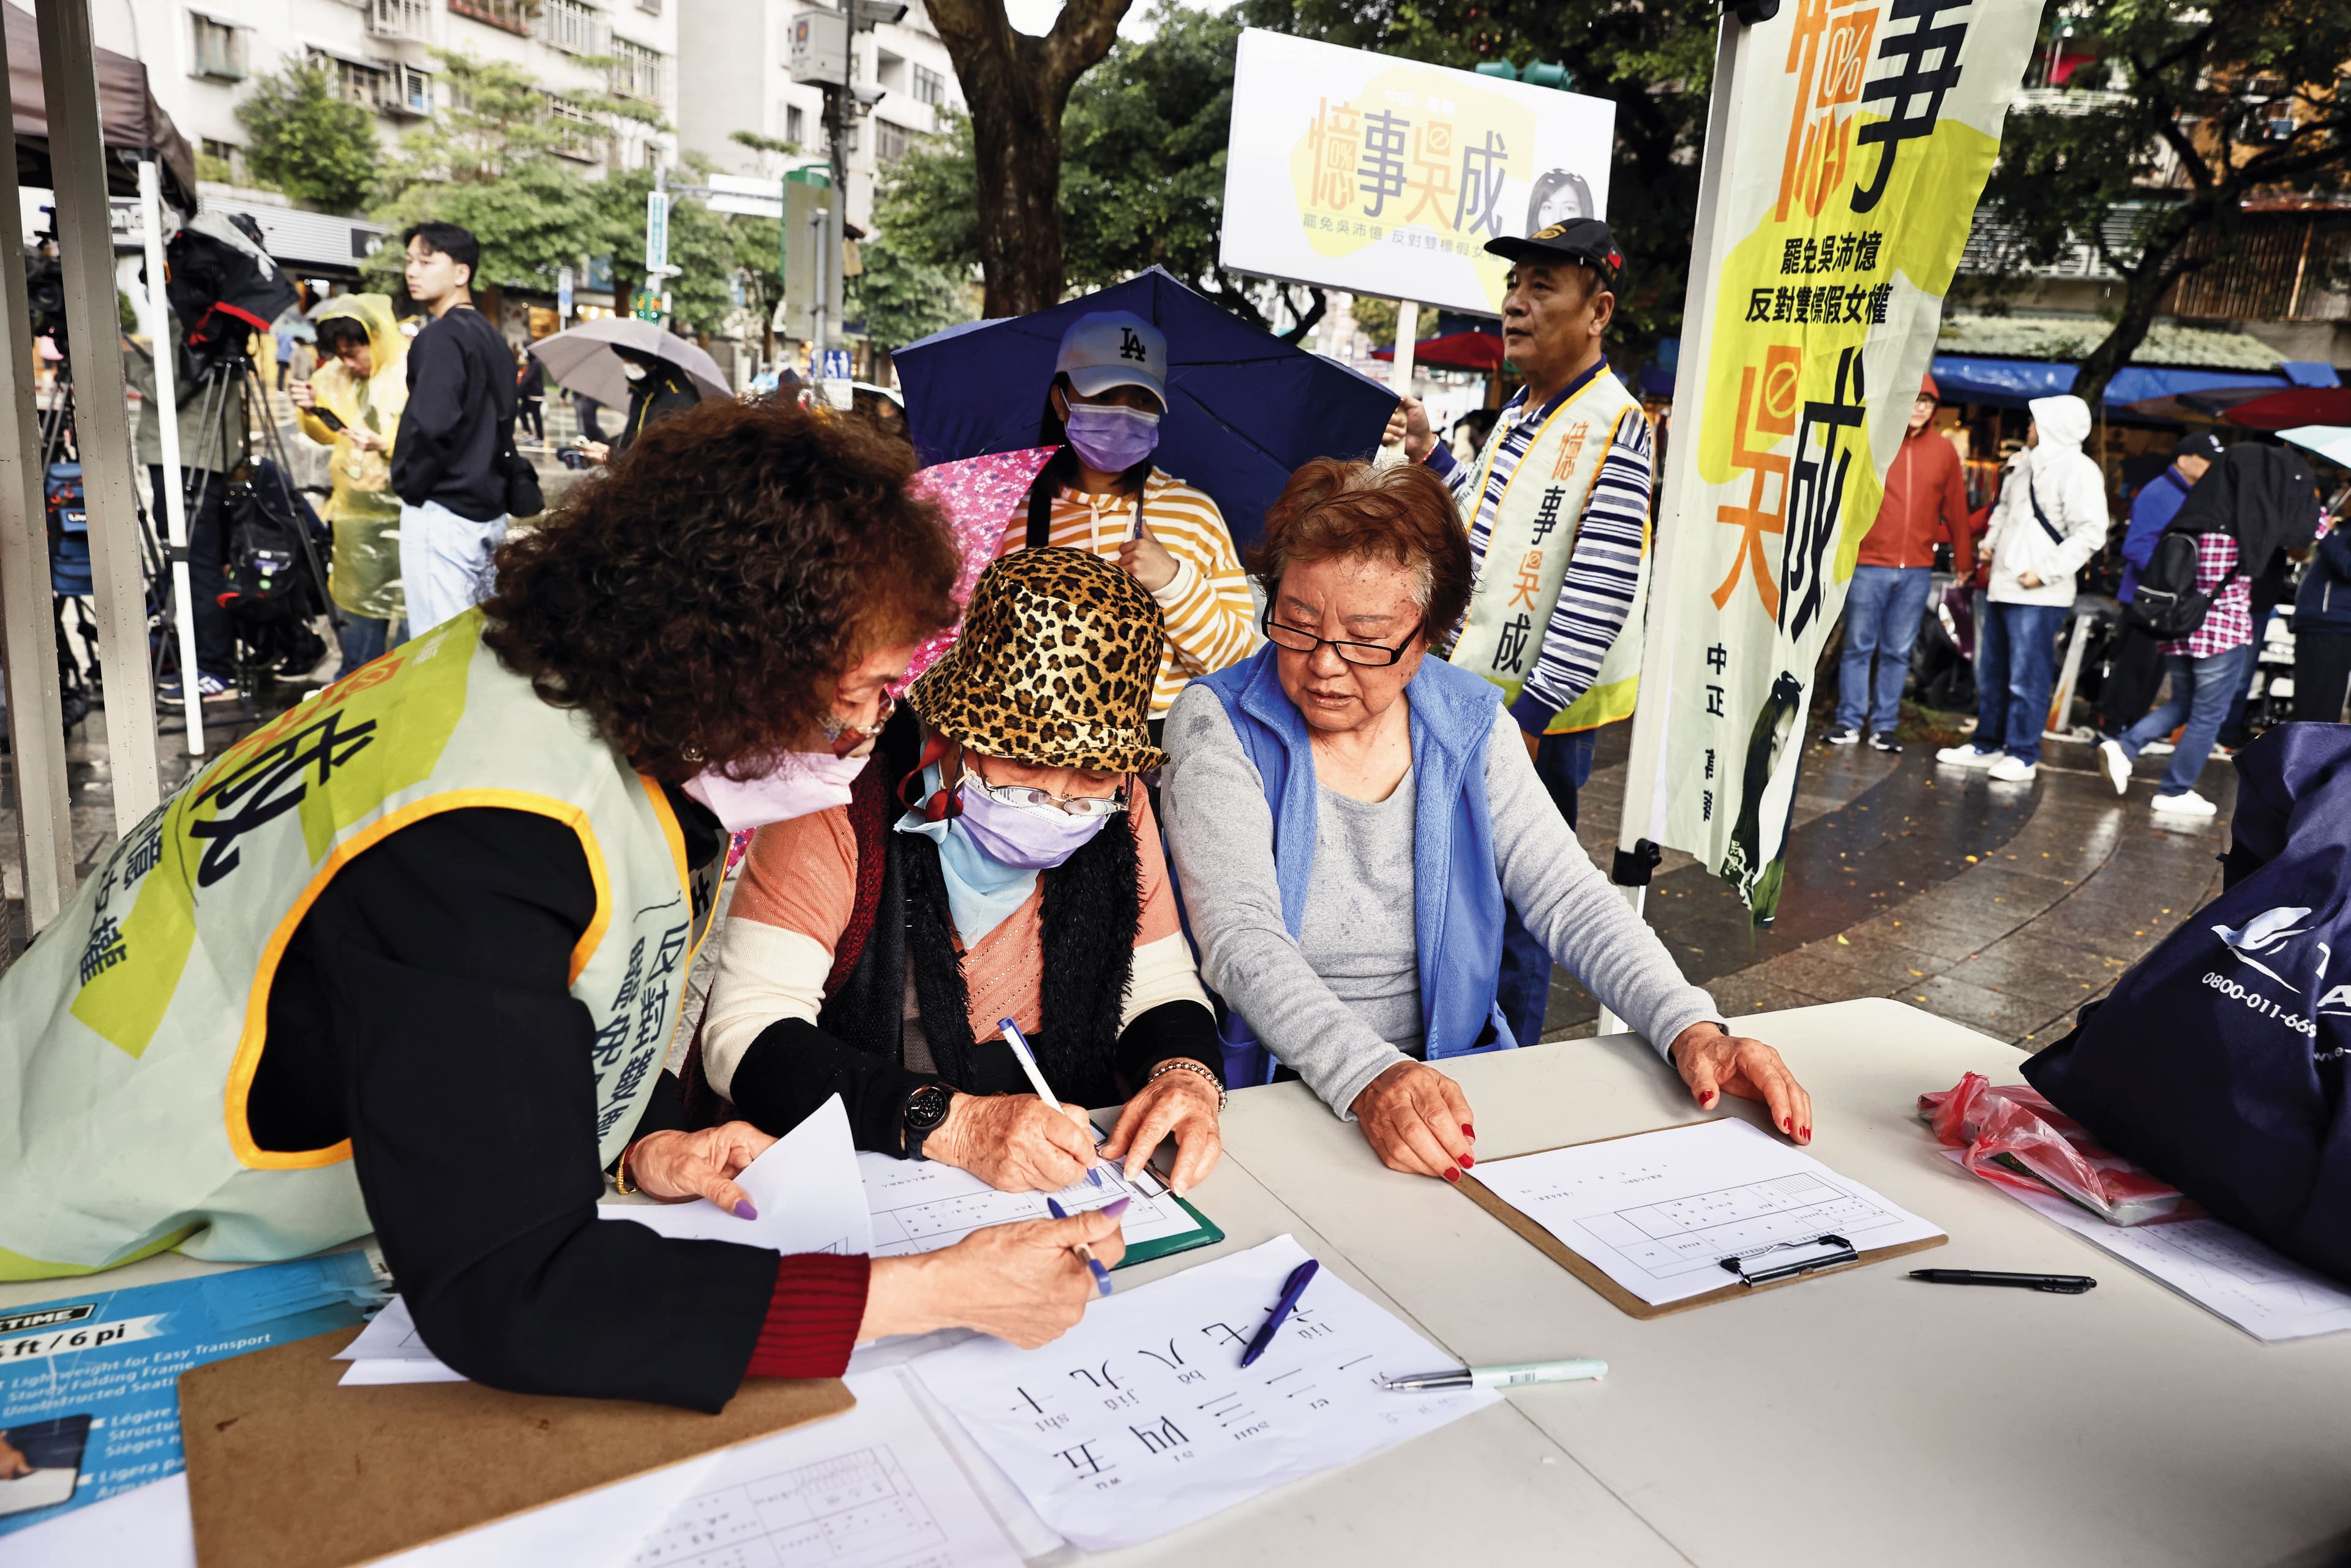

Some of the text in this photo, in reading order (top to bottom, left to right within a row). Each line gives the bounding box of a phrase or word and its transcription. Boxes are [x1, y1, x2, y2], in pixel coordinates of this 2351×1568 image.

[1303, 212, 1383, 241] 罷免吳沛憶
[1779, 230, 1883, 276] 罷免吳沛憶
[1745, 282, 1894, 325] 反對雙標假女權
[1120, 327, 1146, 362] LA
[1491, 421, 1589, 675] 憶事吳成
[593, 936, 646, 1086] 罷免
[2202, 972, 2317, 1038] 0800-011-669
[13, 1340, 43, 1356] ft
[69, 1330, 88, 1346] 6
[95, 1324, 126, 1346] pi
[1201, 1321, 1249, 1347] 七
[12, 1334, 272, 1389] Lightweight for Easy Transport
[1137, 1337, 1185, 1371] 八
[9, 1360, 195, 1403] Sturdy Folding Frame
[1068, 1359, 1125, 1392] 九
[1264, 1368, 1317, 1398] 二
[1010, 1386, 1055, 1416] 十
[1196, 1391, 1256, 1429] 三
[1128, 1416, 1190, 1457] 四
[1051, 1438, 1117, 1480] 五
